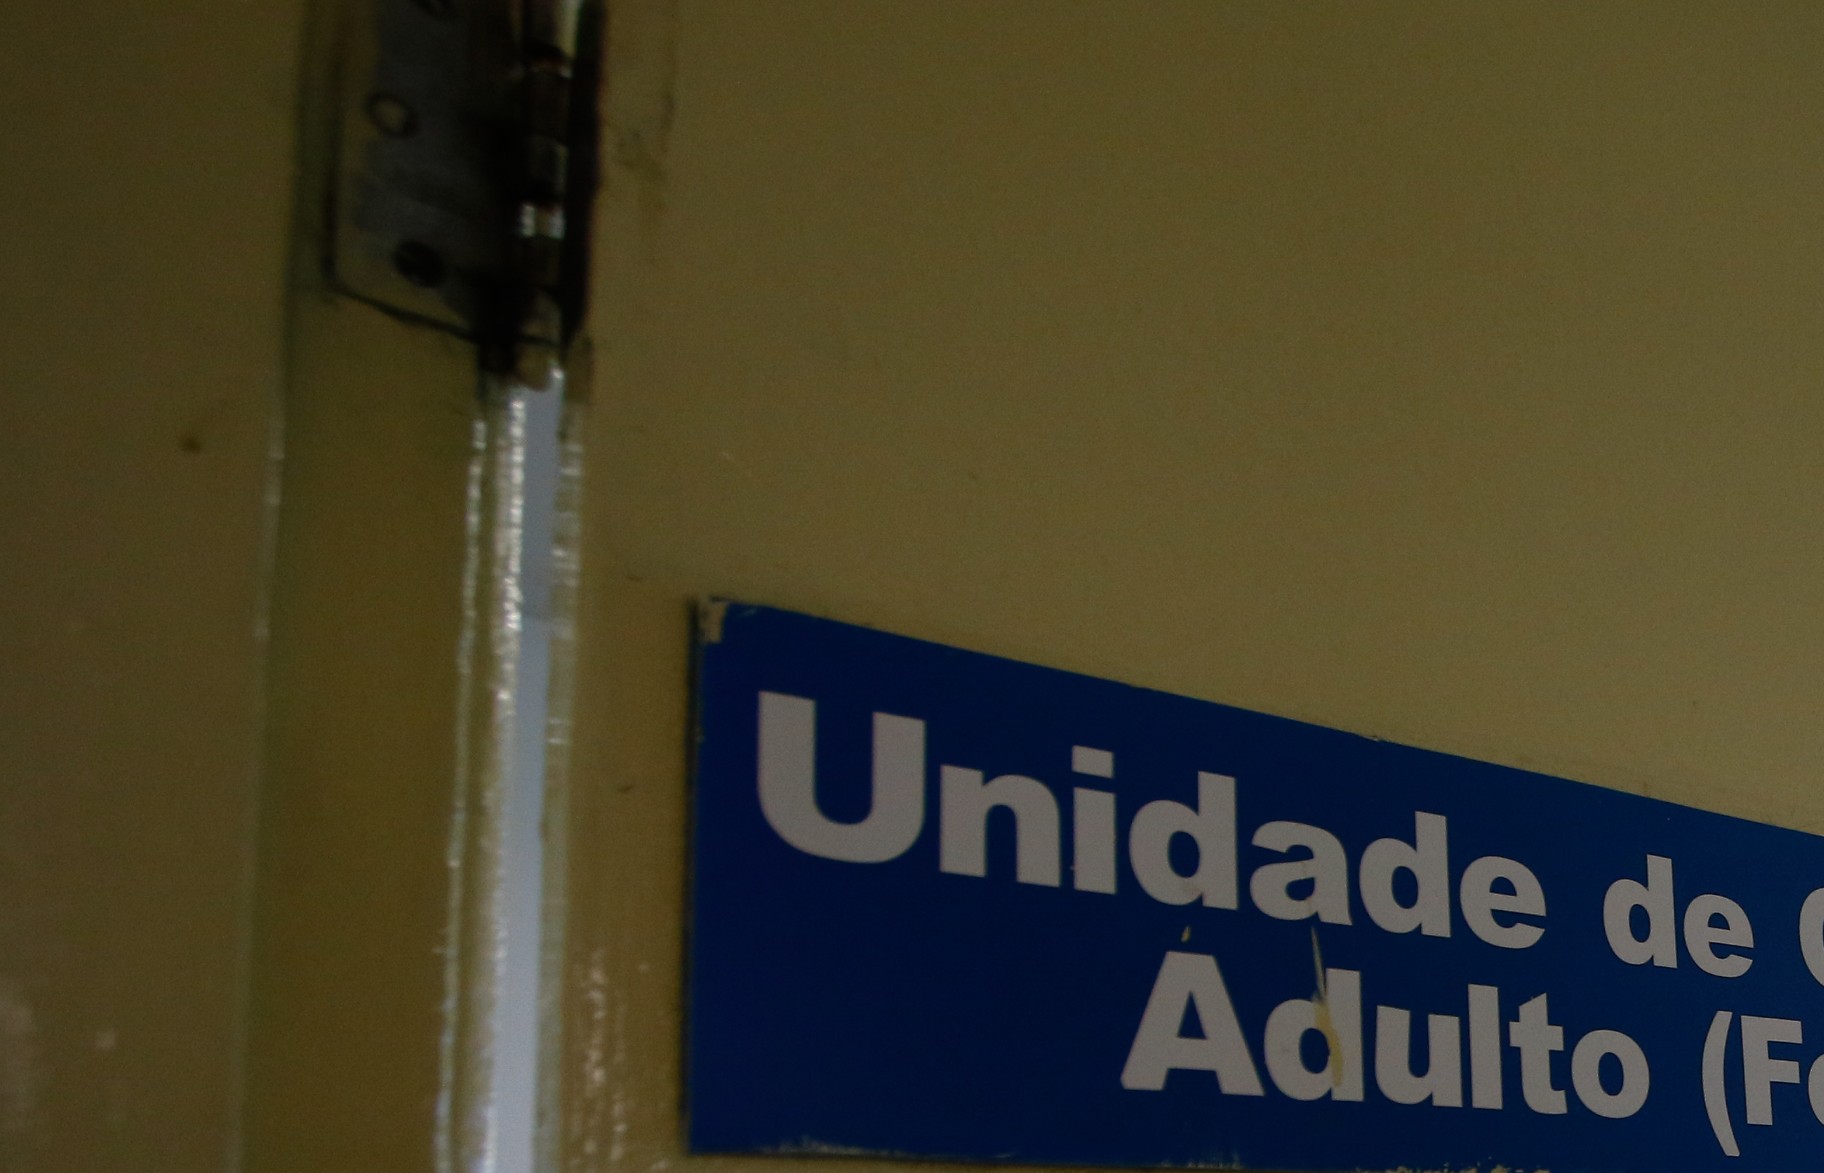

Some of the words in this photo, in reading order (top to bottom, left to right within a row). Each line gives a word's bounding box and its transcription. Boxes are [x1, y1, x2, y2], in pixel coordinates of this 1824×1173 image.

[757, 692, 1547, 950] Unidade
[1602, 854, 1755, 979] de
[1120, 951, 1651, 1120] Adulto
